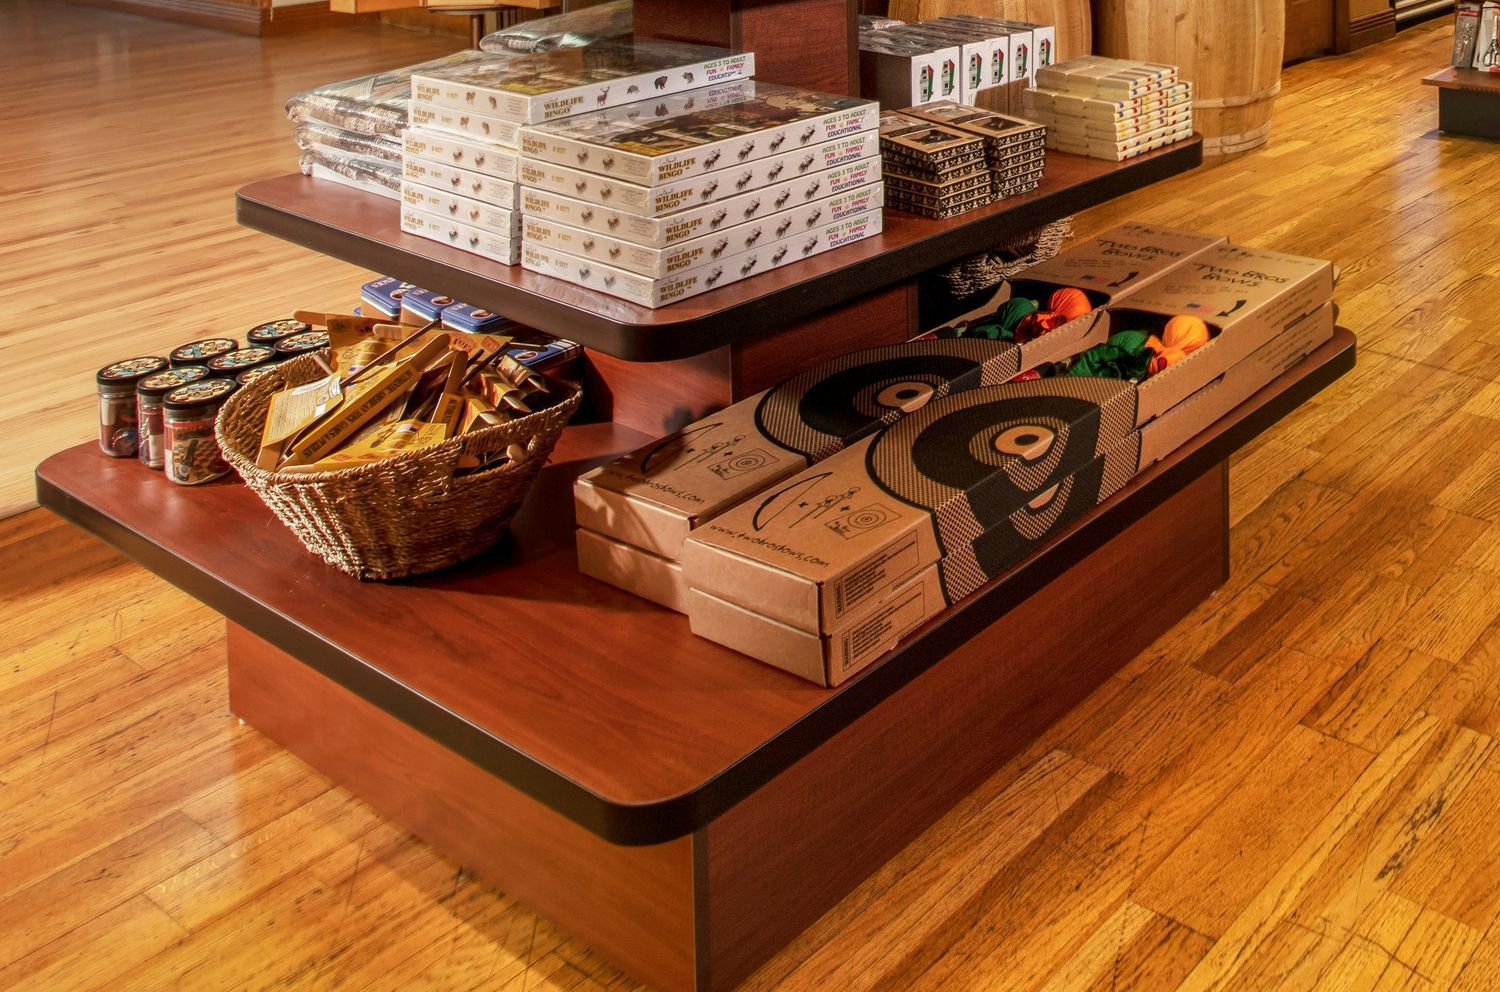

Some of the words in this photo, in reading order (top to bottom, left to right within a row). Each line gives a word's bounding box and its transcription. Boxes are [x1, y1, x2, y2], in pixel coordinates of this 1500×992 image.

[543, 96, 585, 111] WILDLIFE
[544, 108, 570, 119] BINGO
[823, 116, 837, 125] AGES
[850, 109, 866, 118] ADULT
[827, 124, 862, 138] EDUCATIONAL
[822, 144, 836, 153] AGES
[850, 137, 865, 146] ADULT
[845, 144, 864, 154] FAMILY
[658, 157, 696, 173] WILDLIFE
[826, 152, 862, 166] EDUCATIONAL
[658, 168, 683, 180] BINGO
[827, 171, 840, 180] AGES
[854, 162, 870, 171] ADULT
[850, 170, 868, 179] FAMILY
[832, 177, 865, 192] EDUCATIONAL
[655, 188, 693, 205] WILDLIFE
[829, 198, 842, 207] AGES
[856, 189, 871, 199] ADULT
[851, 197, 870, 207] FAMILY
[655, 199, 680, 212] BINGO
[833, 205, 867, 220] EDUCATIONAL
[665, 218, 703, 234] WILDLIFE
[825, 226, 840, 235] AGES
[853, 216, 869, 226] ADULT
[828, 233, 839, 241] FUN
[849, 224, 867, 234] FAMILY
[665, 230, 690, 242] BINGO
[830, 231, 865, 247] EDUCATIONAL
[667, 247, 704, 264] WILDLIFE
[667, 259, 691, 273] BINGO
[660, 276, 698, 294] WILDLIFE
[660, 288, 684, 302] BINGO
